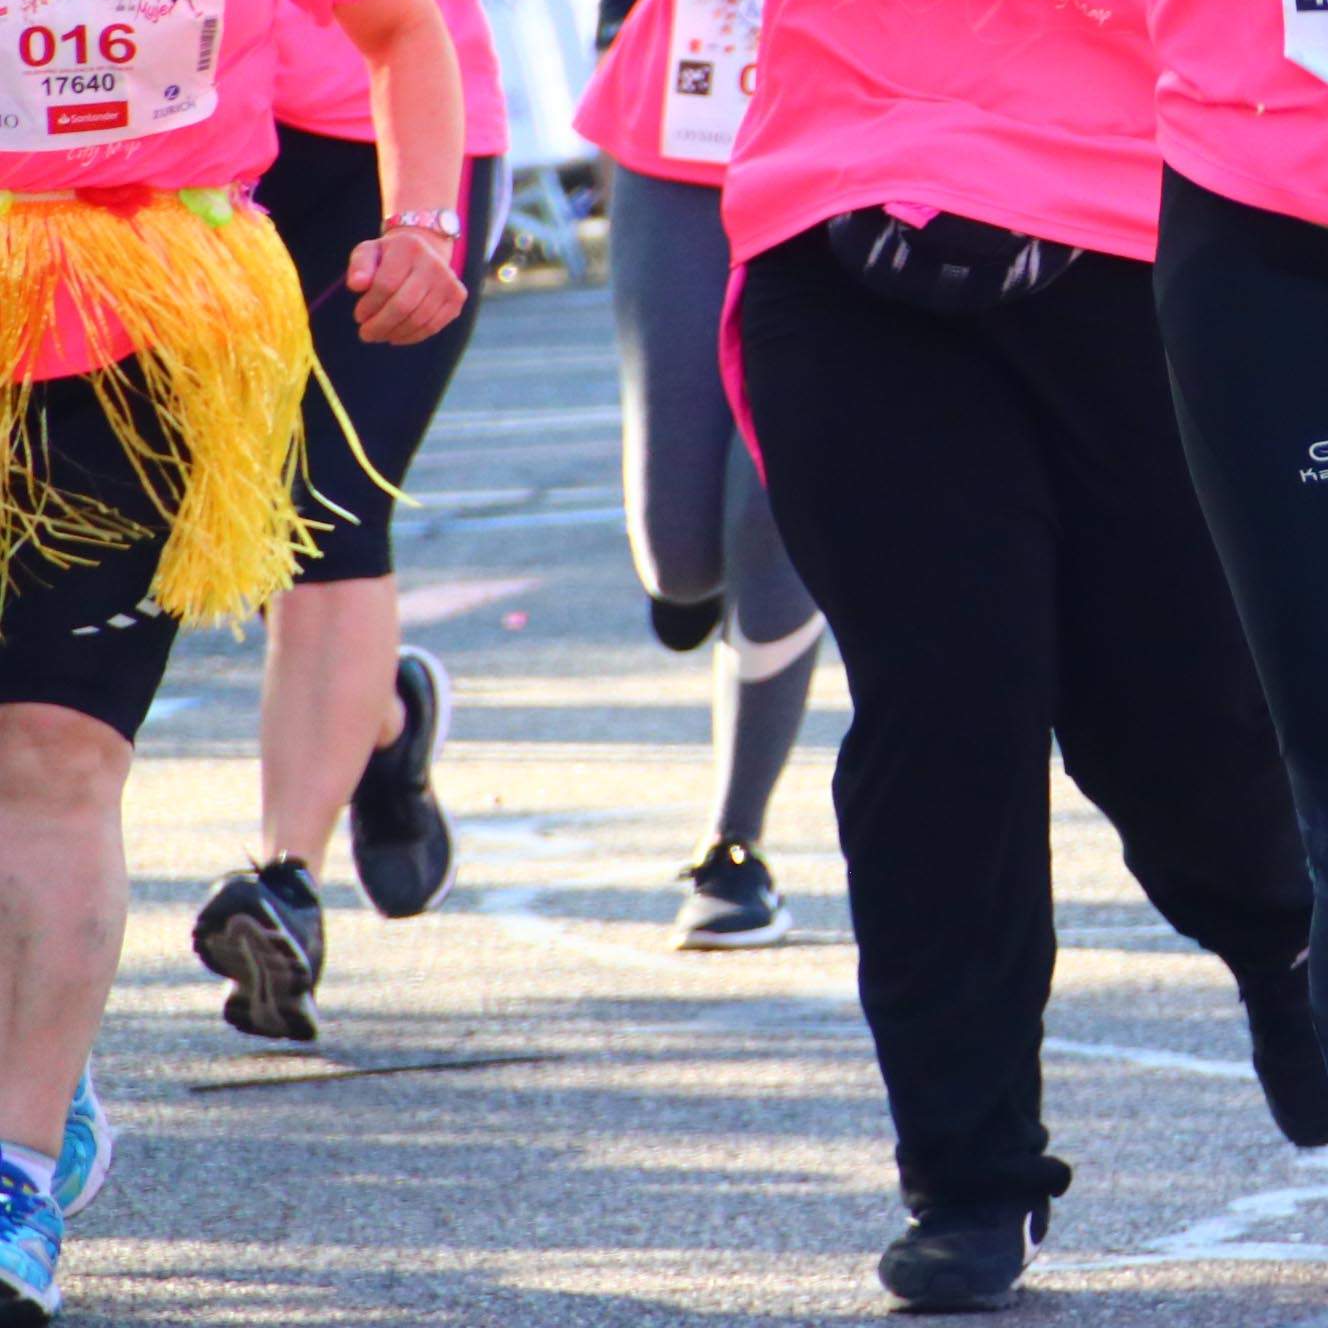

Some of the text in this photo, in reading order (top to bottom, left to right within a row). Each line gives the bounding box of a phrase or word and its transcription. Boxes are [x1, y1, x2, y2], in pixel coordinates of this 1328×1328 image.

[19, 23, 137, 67] 016
[41, 73, 115, 96] 17640
[71, 111, 119, 123] Santander
